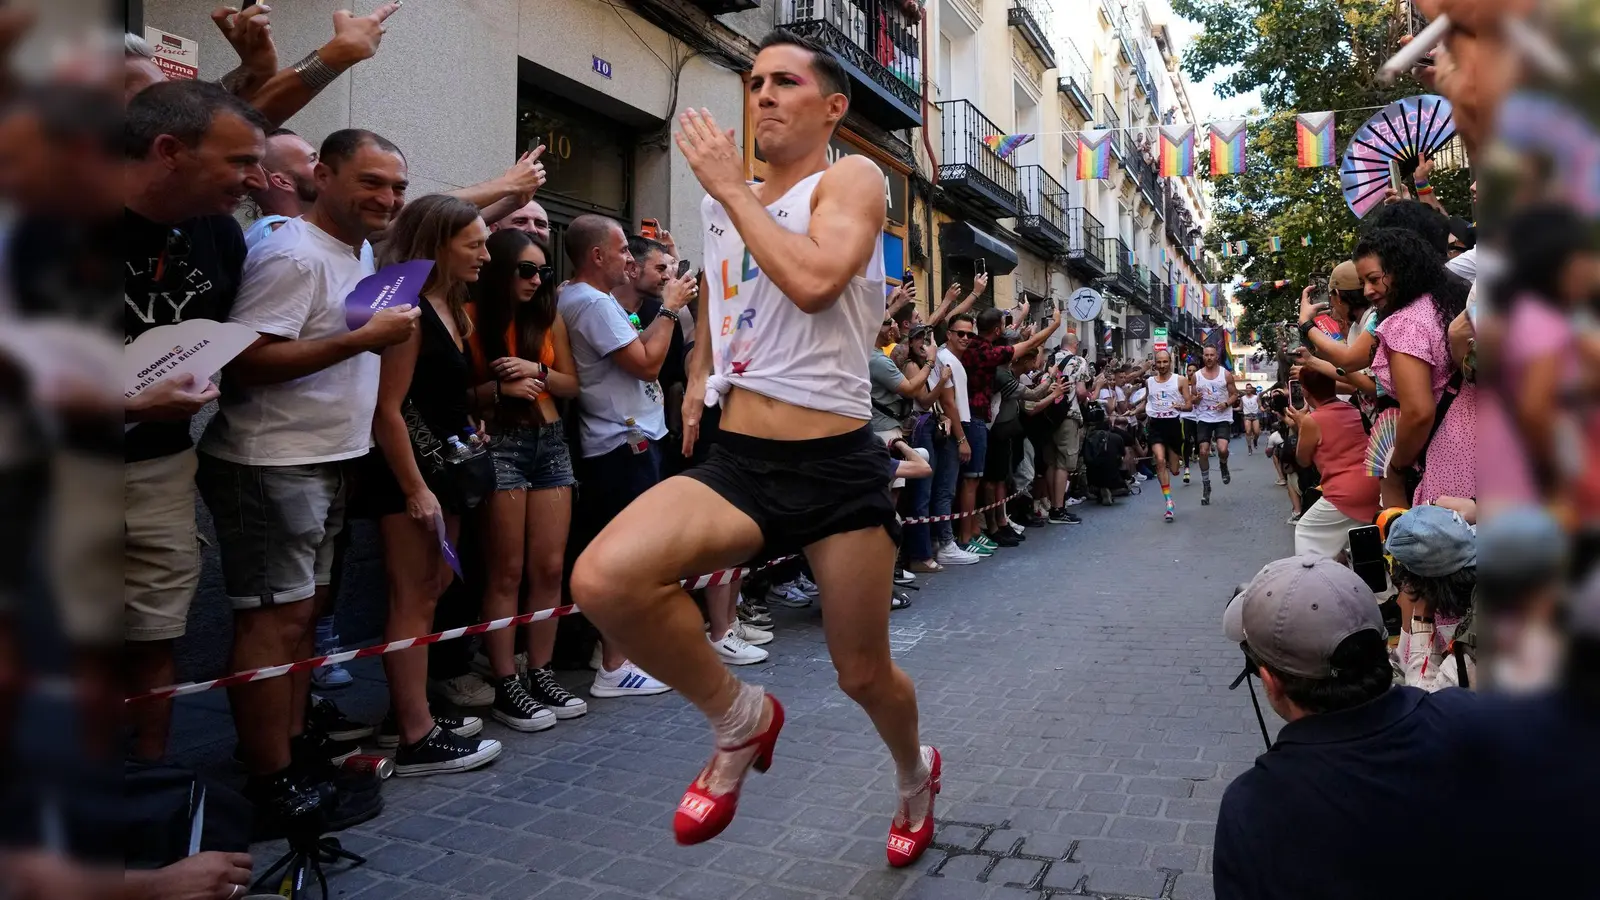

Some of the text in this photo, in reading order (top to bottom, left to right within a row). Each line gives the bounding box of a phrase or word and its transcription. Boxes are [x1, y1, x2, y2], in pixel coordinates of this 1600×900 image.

[154, 43, 188, 55] Direct
[151, 57, 194, 75] Alarma
[597, 60, 609, 74] 10
[548, 130, 571, 159] 10
[390, 276, 405, 294] BELLEZA
[135, 377, 154, 391] PAÍS
[154, 369, 167, 377] DE
[166, 361, 178, 369] LA
[177, 339, 210, 362] BELLEZA
[137, 352, 175, 379] COLOMBIA
[889, 836, 911, 851] XXX
